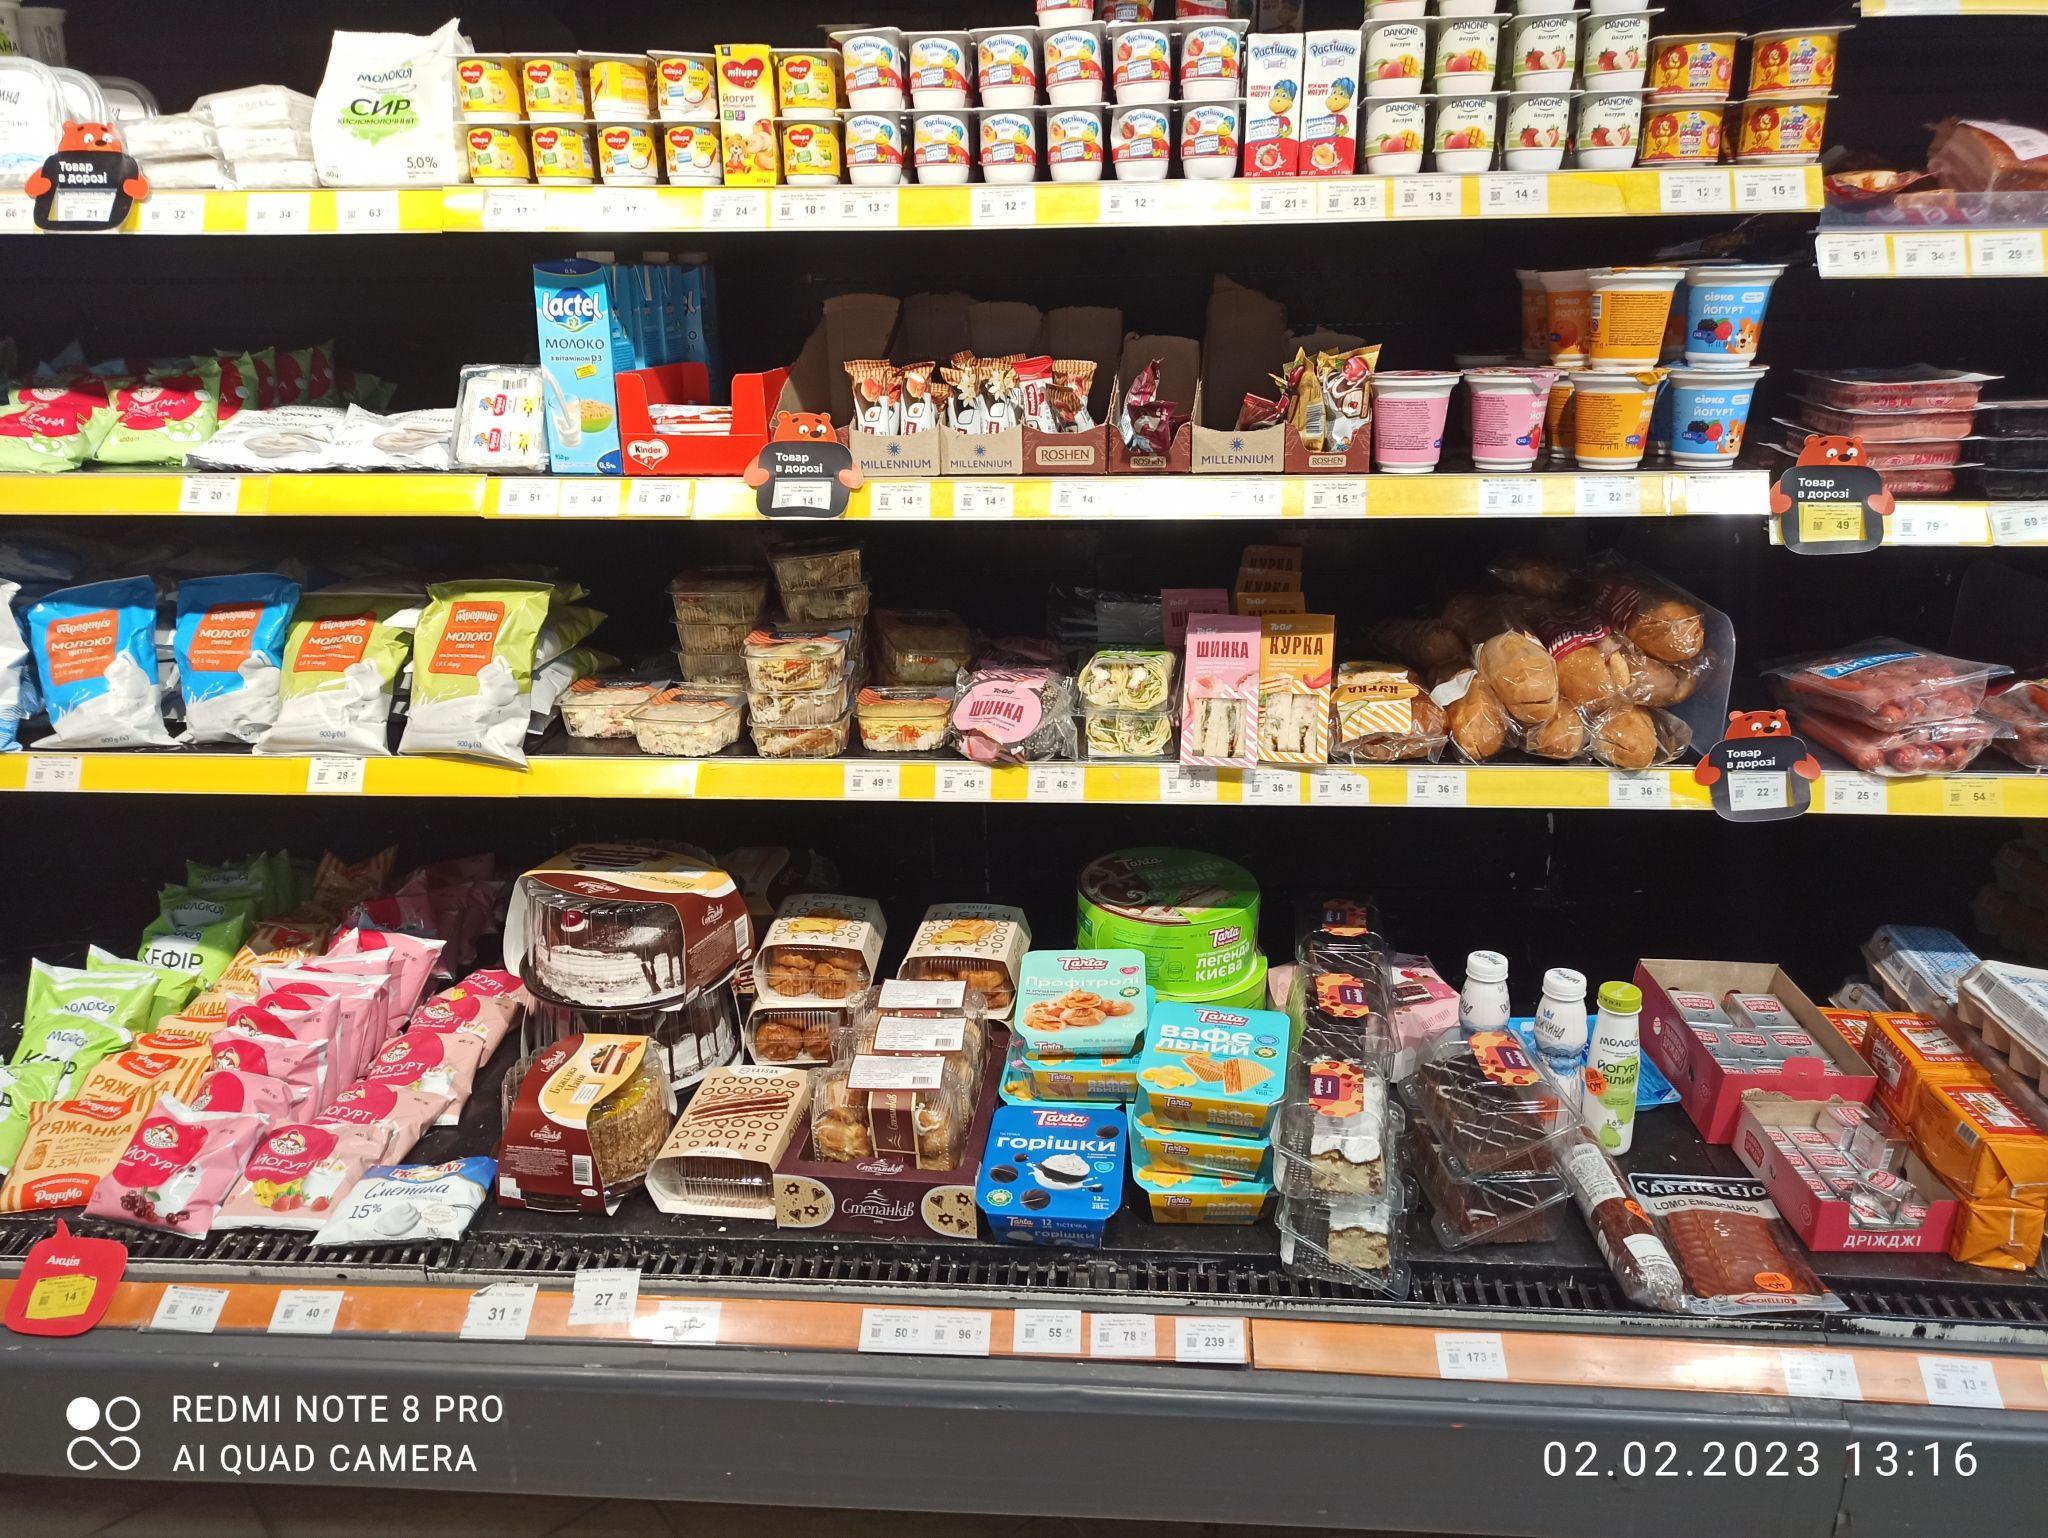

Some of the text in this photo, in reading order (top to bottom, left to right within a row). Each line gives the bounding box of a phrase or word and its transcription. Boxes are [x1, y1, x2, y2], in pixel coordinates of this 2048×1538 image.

[1453, 21, 1489, 31] DANONE
[1531, 18, 1568, 29] DANONE
[1604, 18, 1641, 30] DANONE
[1383, 27, 1418, 36] DANONE
[727, 68, 758, 78] milupa
[722, 95, 754, 103] ЙОГУРТ
[1528, 98, 1563, 107] DANONE
[1598, 97, 1633, 106] DANONE
[350, 98, 411, 116] СИР
[1385, 104, 1420, 113] DANONE
[1450, 100, 1486, 109] DANONE
[60, 161, 93, 173] Товар
[406, 156, 438, 169] 5,0%
[68, 172, 107, 185] дорозі
[1516, 190, 1528, 198] 14
[1772, 186, 1785, 194] 15
[1429, 192, 1441, 200] 13
[1005, 202, 1016, 210] 12
[1135, 198, 1146, 207] 12
[1285, 199, 1296, 208] 21
[1354, 197, 1366, 206] 23
[369, 209, 380, 217] 63
[736, 207, 747, 215] 24
[805, 206, 816, 214] 18
[868, 204, 879, 212] 13
[174, 210, 185, 218] 32
[1854, 252, 1865, 260] 51
[1703, 304, 1744, 314] ЙОГУРТ
[545, 338, 605, 350] МОЛОКО
[1693, 407, 1735, 417] ЙОГУРТ
[635, 445, 662, 455] Kinder
[1041, 448, 1090, 460] ROSHEN
[775, 452, 809, 464] Товар
[1201, 454, 1274, 465] MILLENNIUM
[1312, 456, 1343, 465] ROSHEN
[784, 463, 823, 474] дорозі
[861, 460, 931, 469] MILLENNIUM
[950, 460, 1012, 468] MILLENNIUM
[1798, 478, 1835, 488] Товар
[211, 492, 222, 500] 20
[1336, 494, 1348, 503] 15
[1609, 492, 1621, 501] 22
[1808, 488, 1849, 500] дорозі
[985, 497, 996, 505] 14
[1836, 521, 1849, 529] 49
[199, 629, 250, 638] МОЛОКО
[445, 632, 492, 641] МОЛОКО
[51, 636, 112, 652] МОЛОКО
[308, 634, 363, 646] МОЛОКО
[1196, 641, 1249, 659] ШИНКА
[1270, 636, 1324, 655] КУРКА
[969, 700, 1024, 722] ШИНКА
[1726, 749, 1761, 759] Товар
[1735, 757, 1776, 769] дорозі
[872, 778, 883, 786] 49
[964, 780, 975, 788] 45
[1273, 784, 1283, 792] 36
[1341, 784, 1352, 792] 45
[1438, 785, 1449, 793] 36
[1641, 787, 1652, 795] 36
[1757, 788, 1768, 796] 22
[1857, 792, 1869, 800] 25
[1974, 793, 1986, 801] 54
[1208, 927, 1241, 942] Tarta
[1196, 943, 1249, 968] легенда
[1057, 957, 1108, 970] Tarta
[1027, 975, 1139, 988] Профітролі
[1195, 1010, 1248, 1026] Tarta
[1160, 1024, 1254, 1043] вафе
[370, 1061, 425, 1076] ЙОГУРТ
[1164, 1096, 1191, 1108] Tarta
[1032, 1110, 1089, 1125] Tarta
[38, 1120, 133, 1137] РЯЖАНКА
[997, 1135, 1115, 1153] горішки
[1161, 1143, 1188, 1153] Tarta
[124, 1145, 182, 1173] ЙОГУРТ
[254, 1152, 315, 1172] ЙОГУРТ
[364, 1182, 450, 1200] Сметана
[1637, 1180, 1767, 1197] CARCHELEJO
[1164, 1195, 1192, 1205] Tarta
[349, 1203, 382, 1219] 15%
[841, 1198, 914, 1218] Степанків
[1653, 1198, 1760, 1214] LOMO EMBUCHADO
[1006, 1216, 1034, 1227] Tarta
[1034, 1230, 1095, 1241] горішки
[1842, 1235, 1922, 1248] ДРІЖДЖІ
[46, 1255, 81, 1267] Акція
[65, 1292, 76, 1301] 14
[594, 1293, 613, 1306] 27
[306, 1308, 320, 1317] 40
[488, 1308, 505, 1320] 31
[895, 1328, 907, 1337] 50
[959, 1330, 971, 1339] 96
[1049, 1328, 1062, 1337] 55
[1124, 1332, 1136, 1341] 78
[1205, 1337, 1224, 1346] 239
